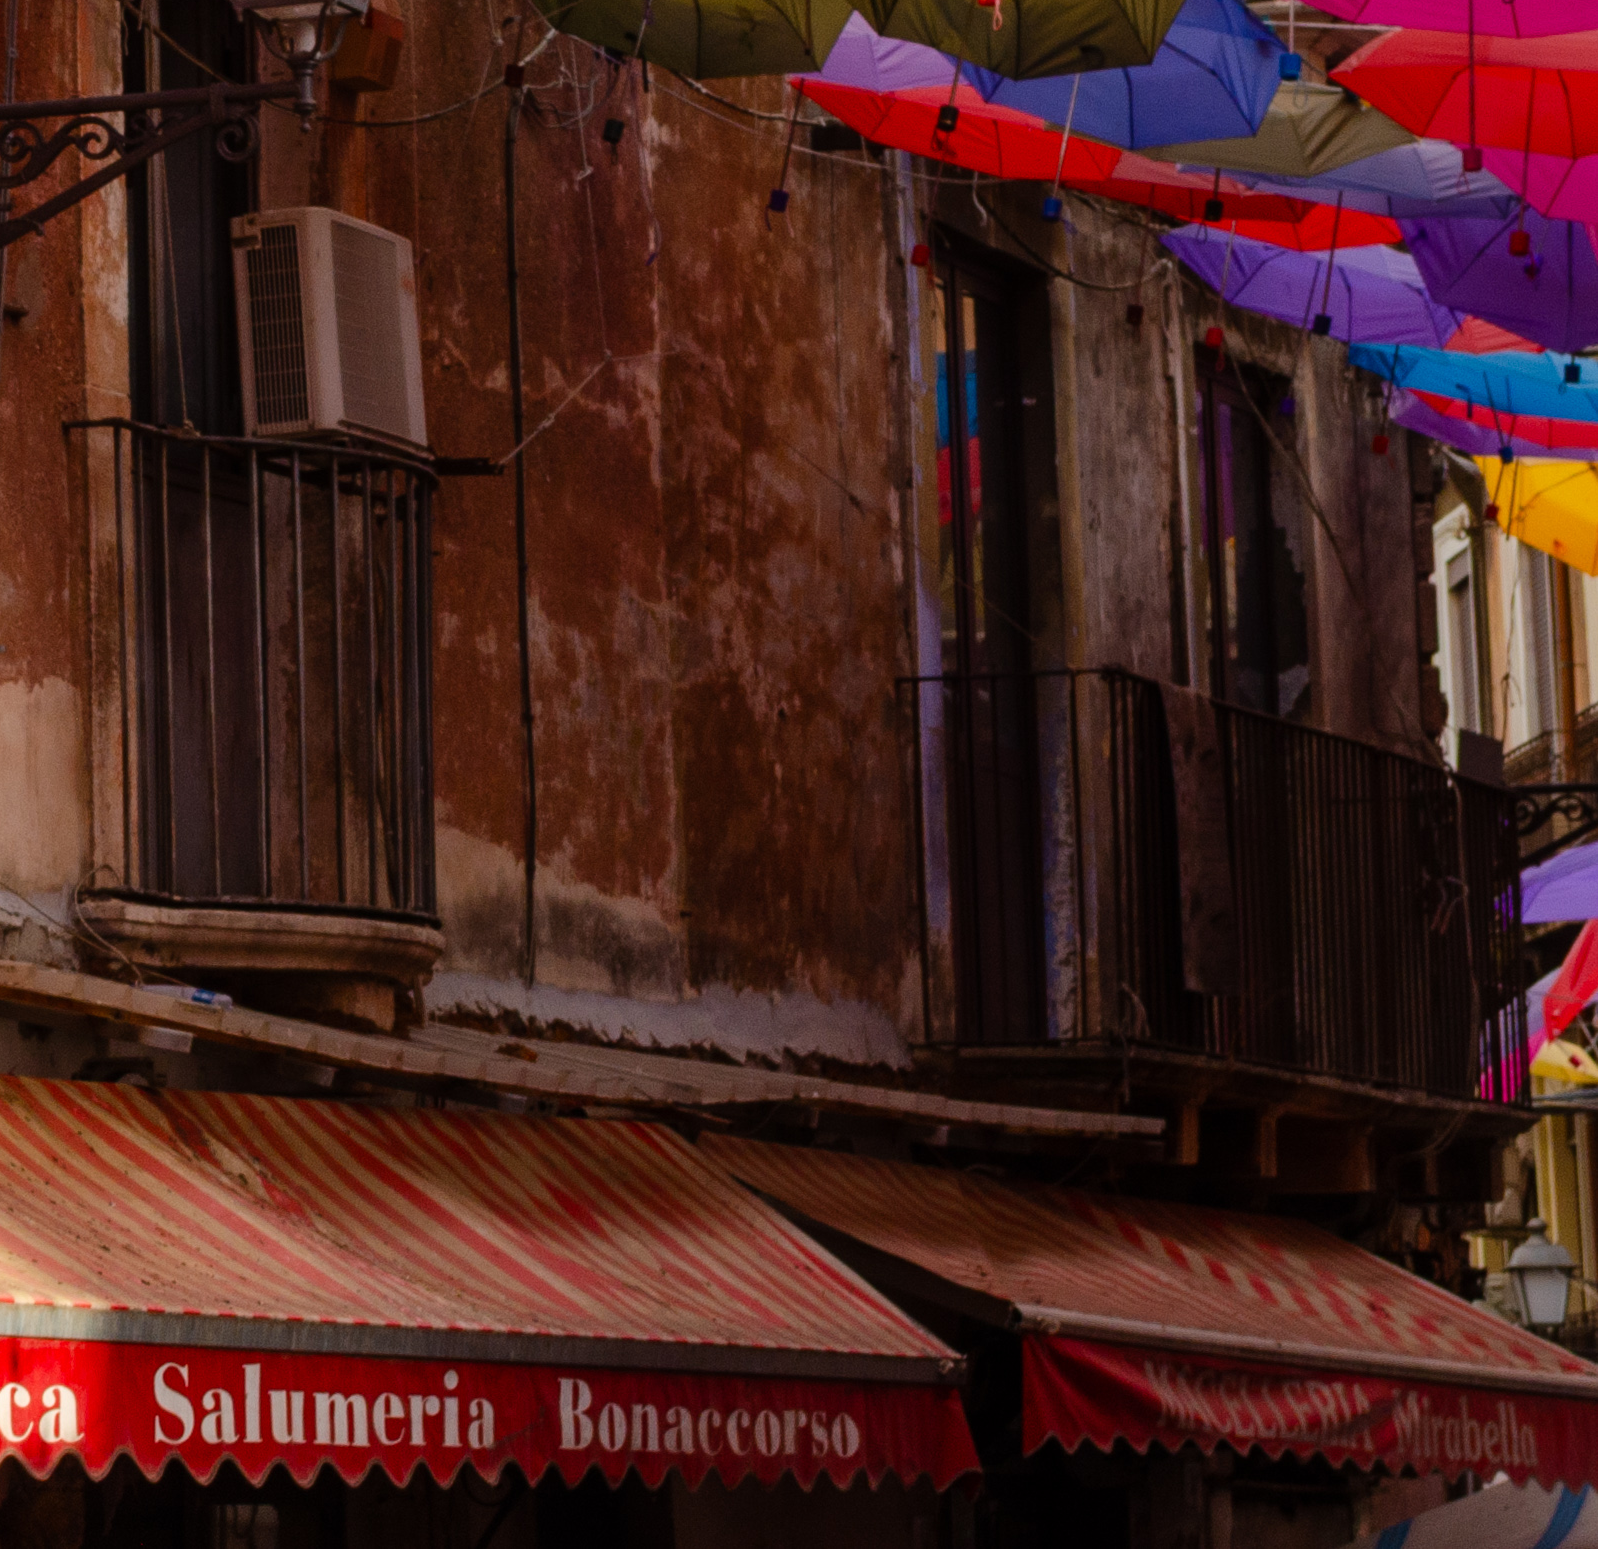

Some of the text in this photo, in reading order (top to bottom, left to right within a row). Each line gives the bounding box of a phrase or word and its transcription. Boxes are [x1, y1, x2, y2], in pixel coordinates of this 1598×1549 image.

[152, 1361, 496, 1449] Salumeria
[557, 1378, 861, 1459] Bonaccorso
[1391, 1388, 1539, 1468] Mirabella
